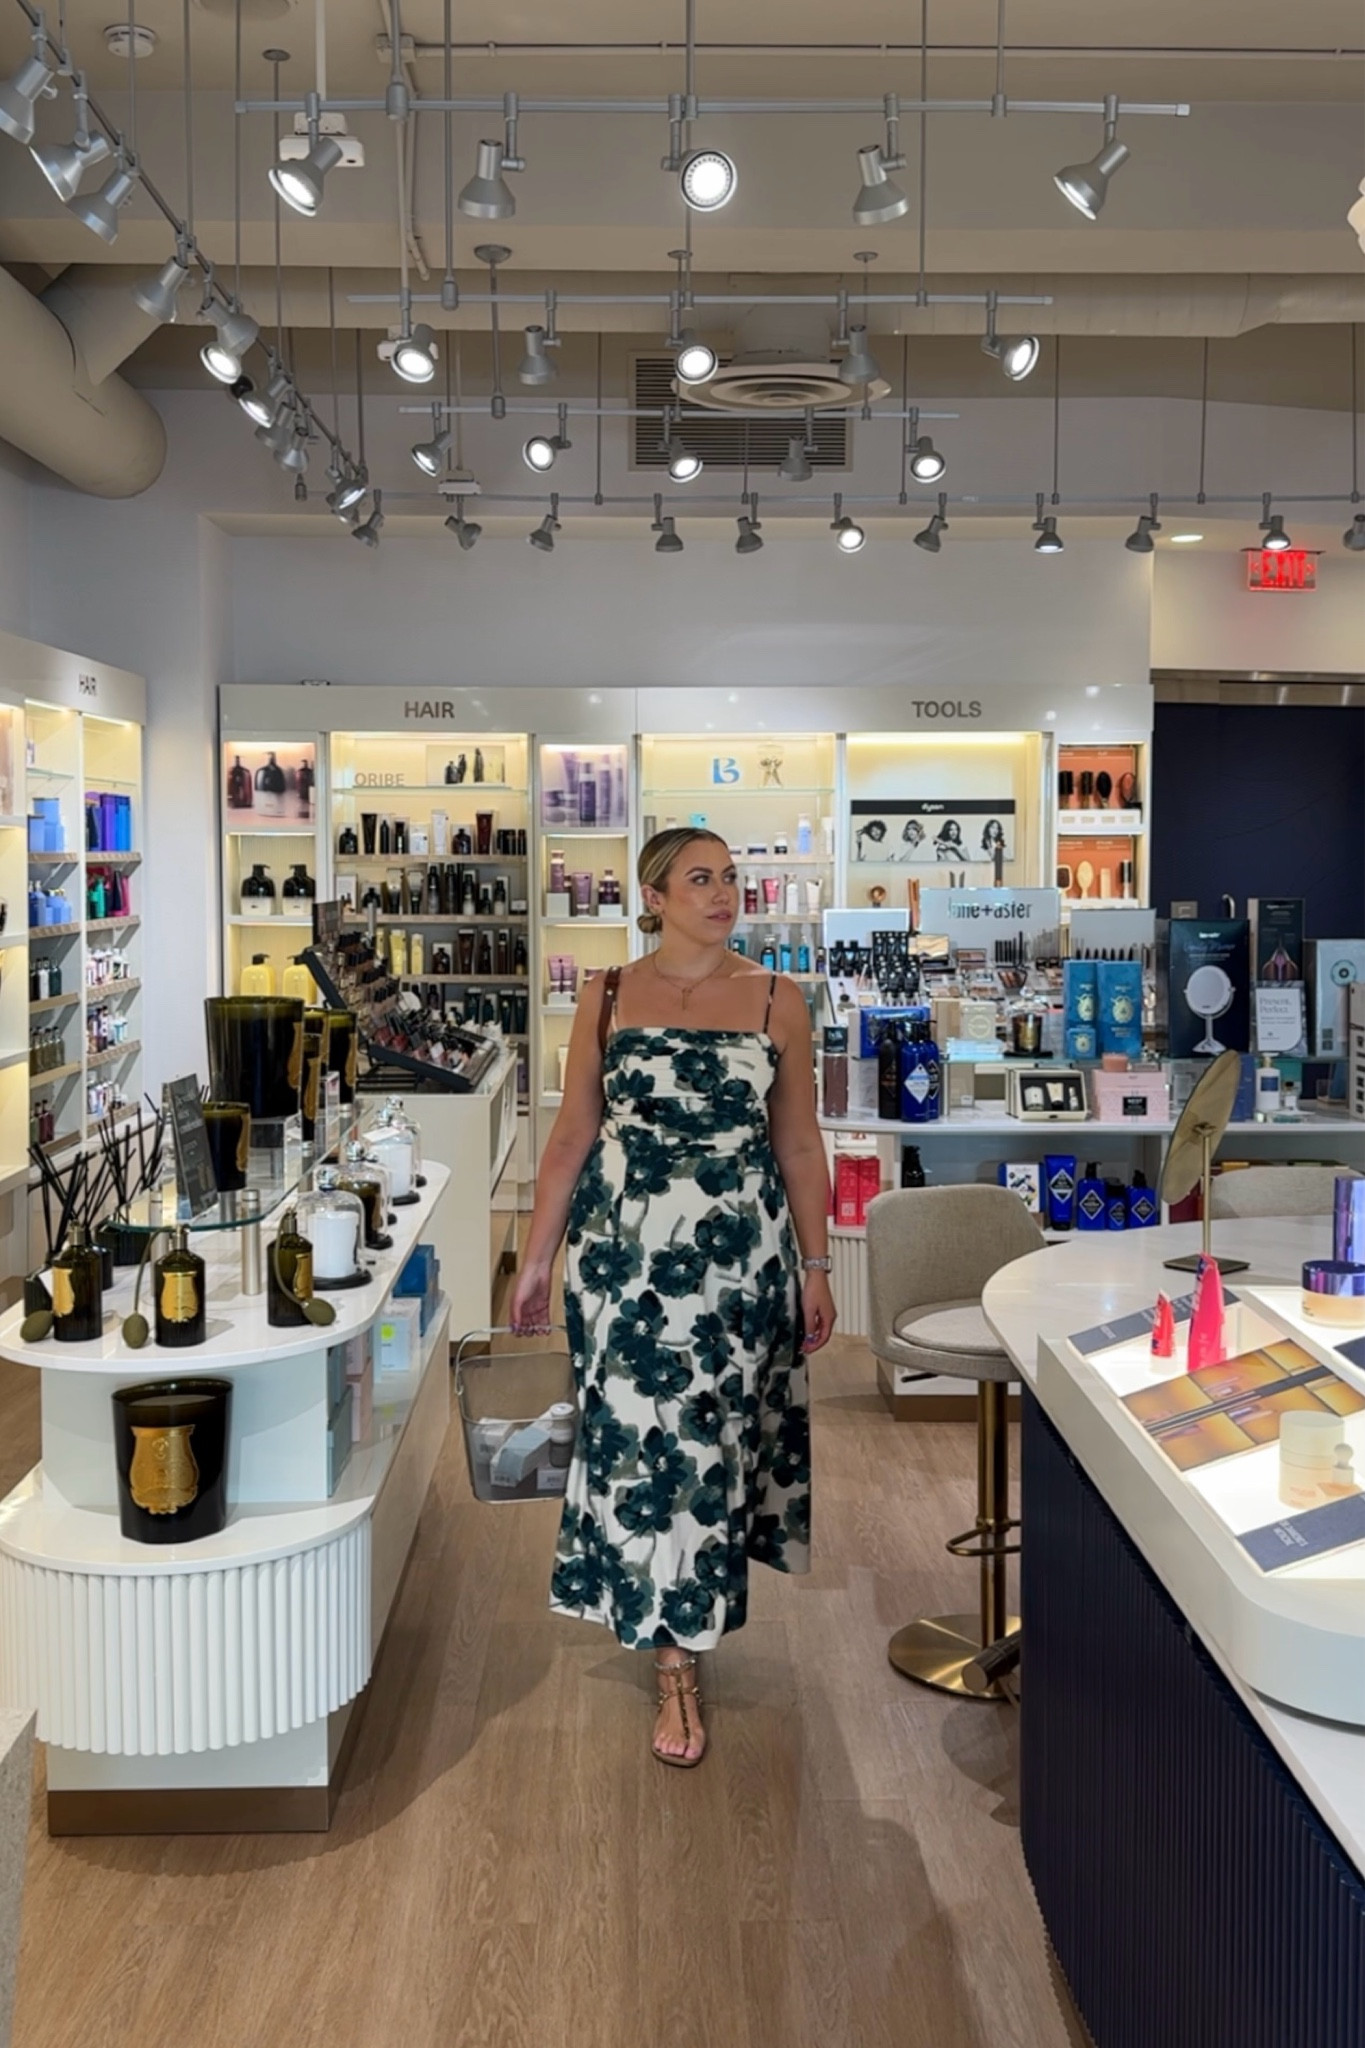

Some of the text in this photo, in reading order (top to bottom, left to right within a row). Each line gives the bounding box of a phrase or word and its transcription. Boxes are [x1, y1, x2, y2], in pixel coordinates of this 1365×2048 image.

[1261, 551, 1306, 587] EXIT
[403, 701, 455, 718] HAIR
[912, 701, 982, 718] TOOLS
[354, 772, 405, 787] ORIBE
